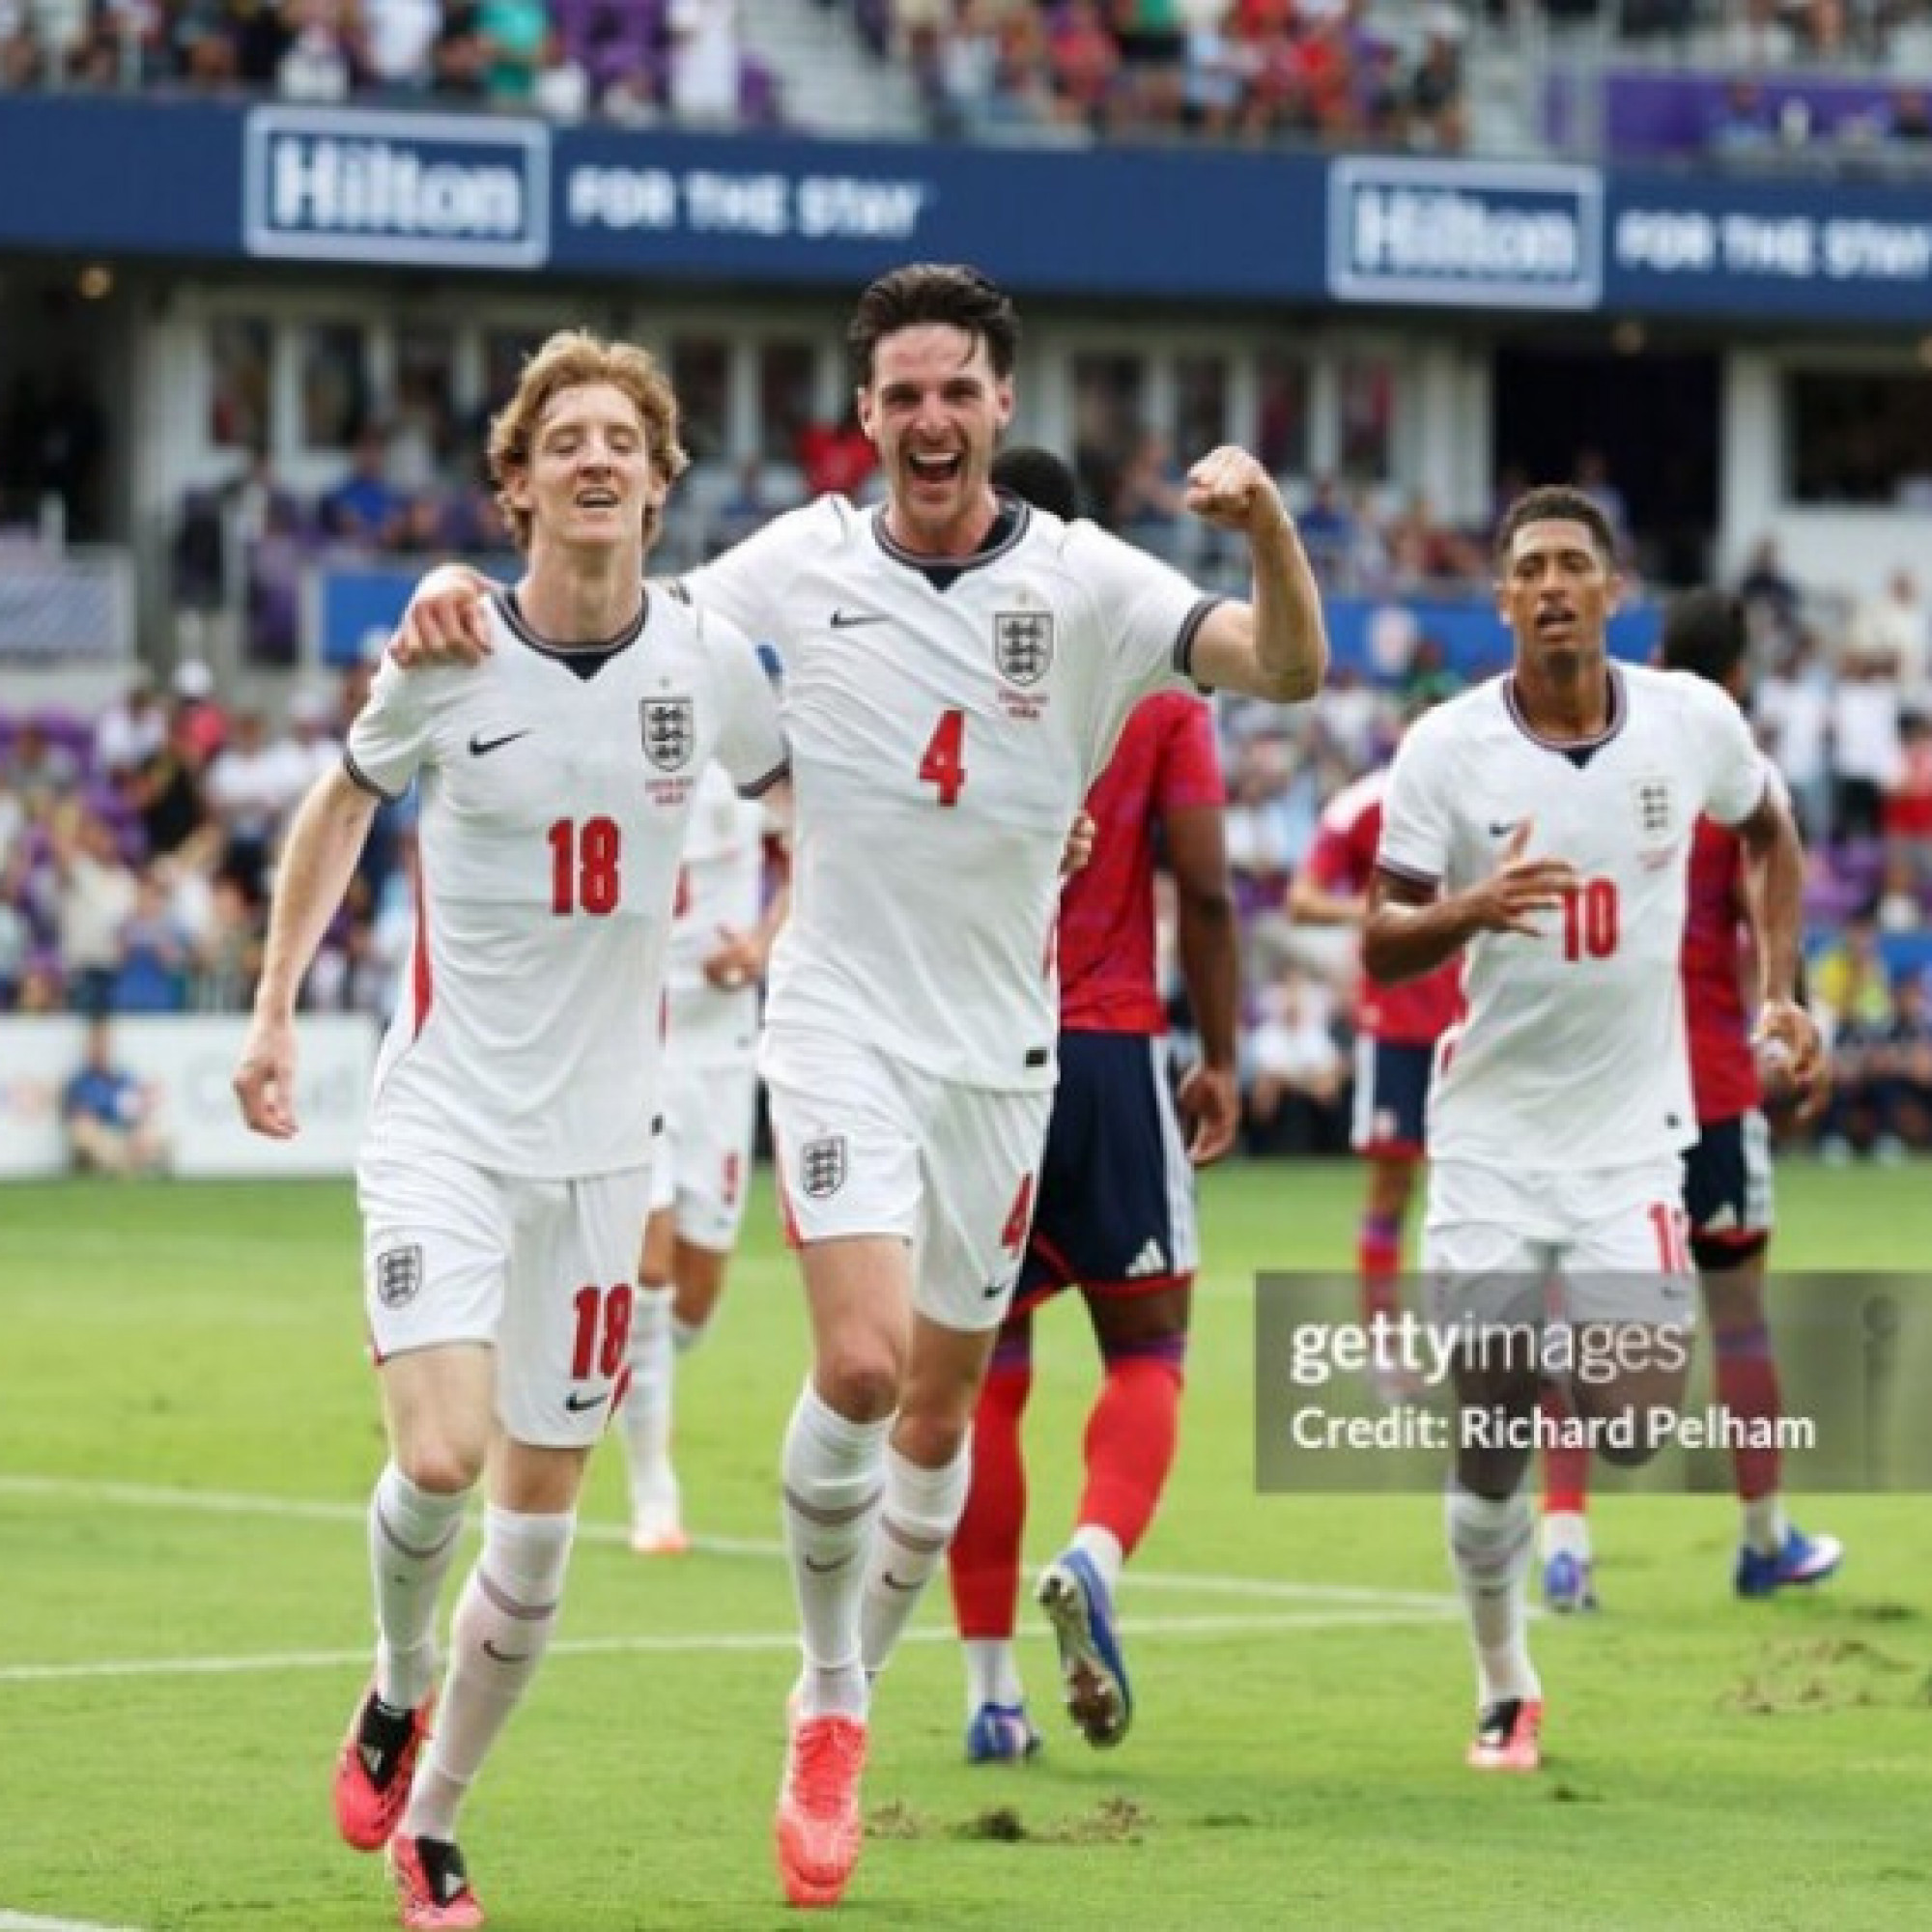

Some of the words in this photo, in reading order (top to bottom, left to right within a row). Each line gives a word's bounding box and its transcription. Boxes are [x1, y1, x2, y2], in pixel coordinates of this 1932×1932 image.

[271, 137, 524, 236] Hilton
[568, 166, 673, 228] FOR
[685, 169, 787, 234] THE
[799, 176, 921, 239] STAY
[1354, 189, 1577, 277] Hilton
[917, 708, 966, 808] 4
[548, 817, 620, 917] 18
[1562, 877, 1618, 962] 10
[1000, 1171, 1033, 1259] 4
[571, 1283, 634, 1381] 18
